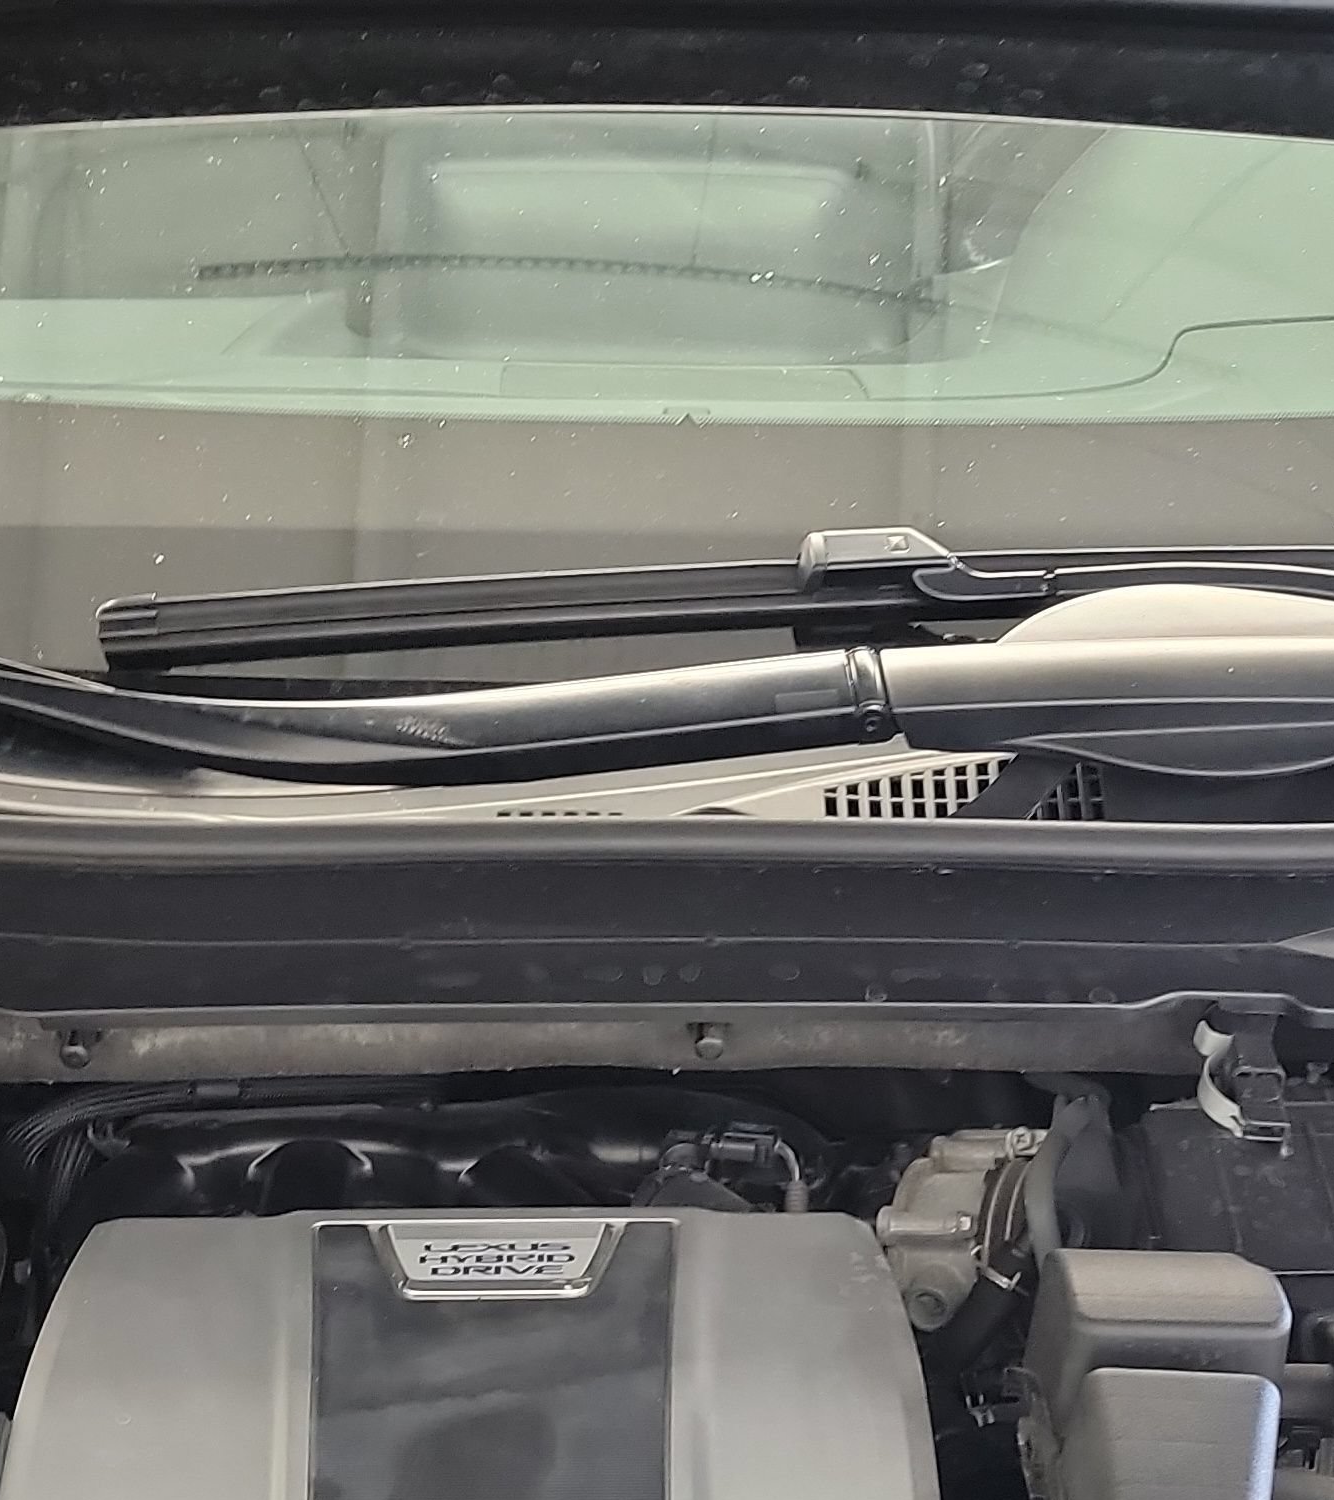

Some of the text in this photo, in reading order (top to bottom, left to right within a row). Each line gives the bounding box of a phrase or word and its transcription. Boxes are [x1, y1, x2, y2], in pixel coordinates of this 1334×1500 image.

[424, 1242, 572, 1252] LEXUS
[419, 1253, 575, 1264] HYBRID
[430, 1264, 564, 1276] DRIVE
